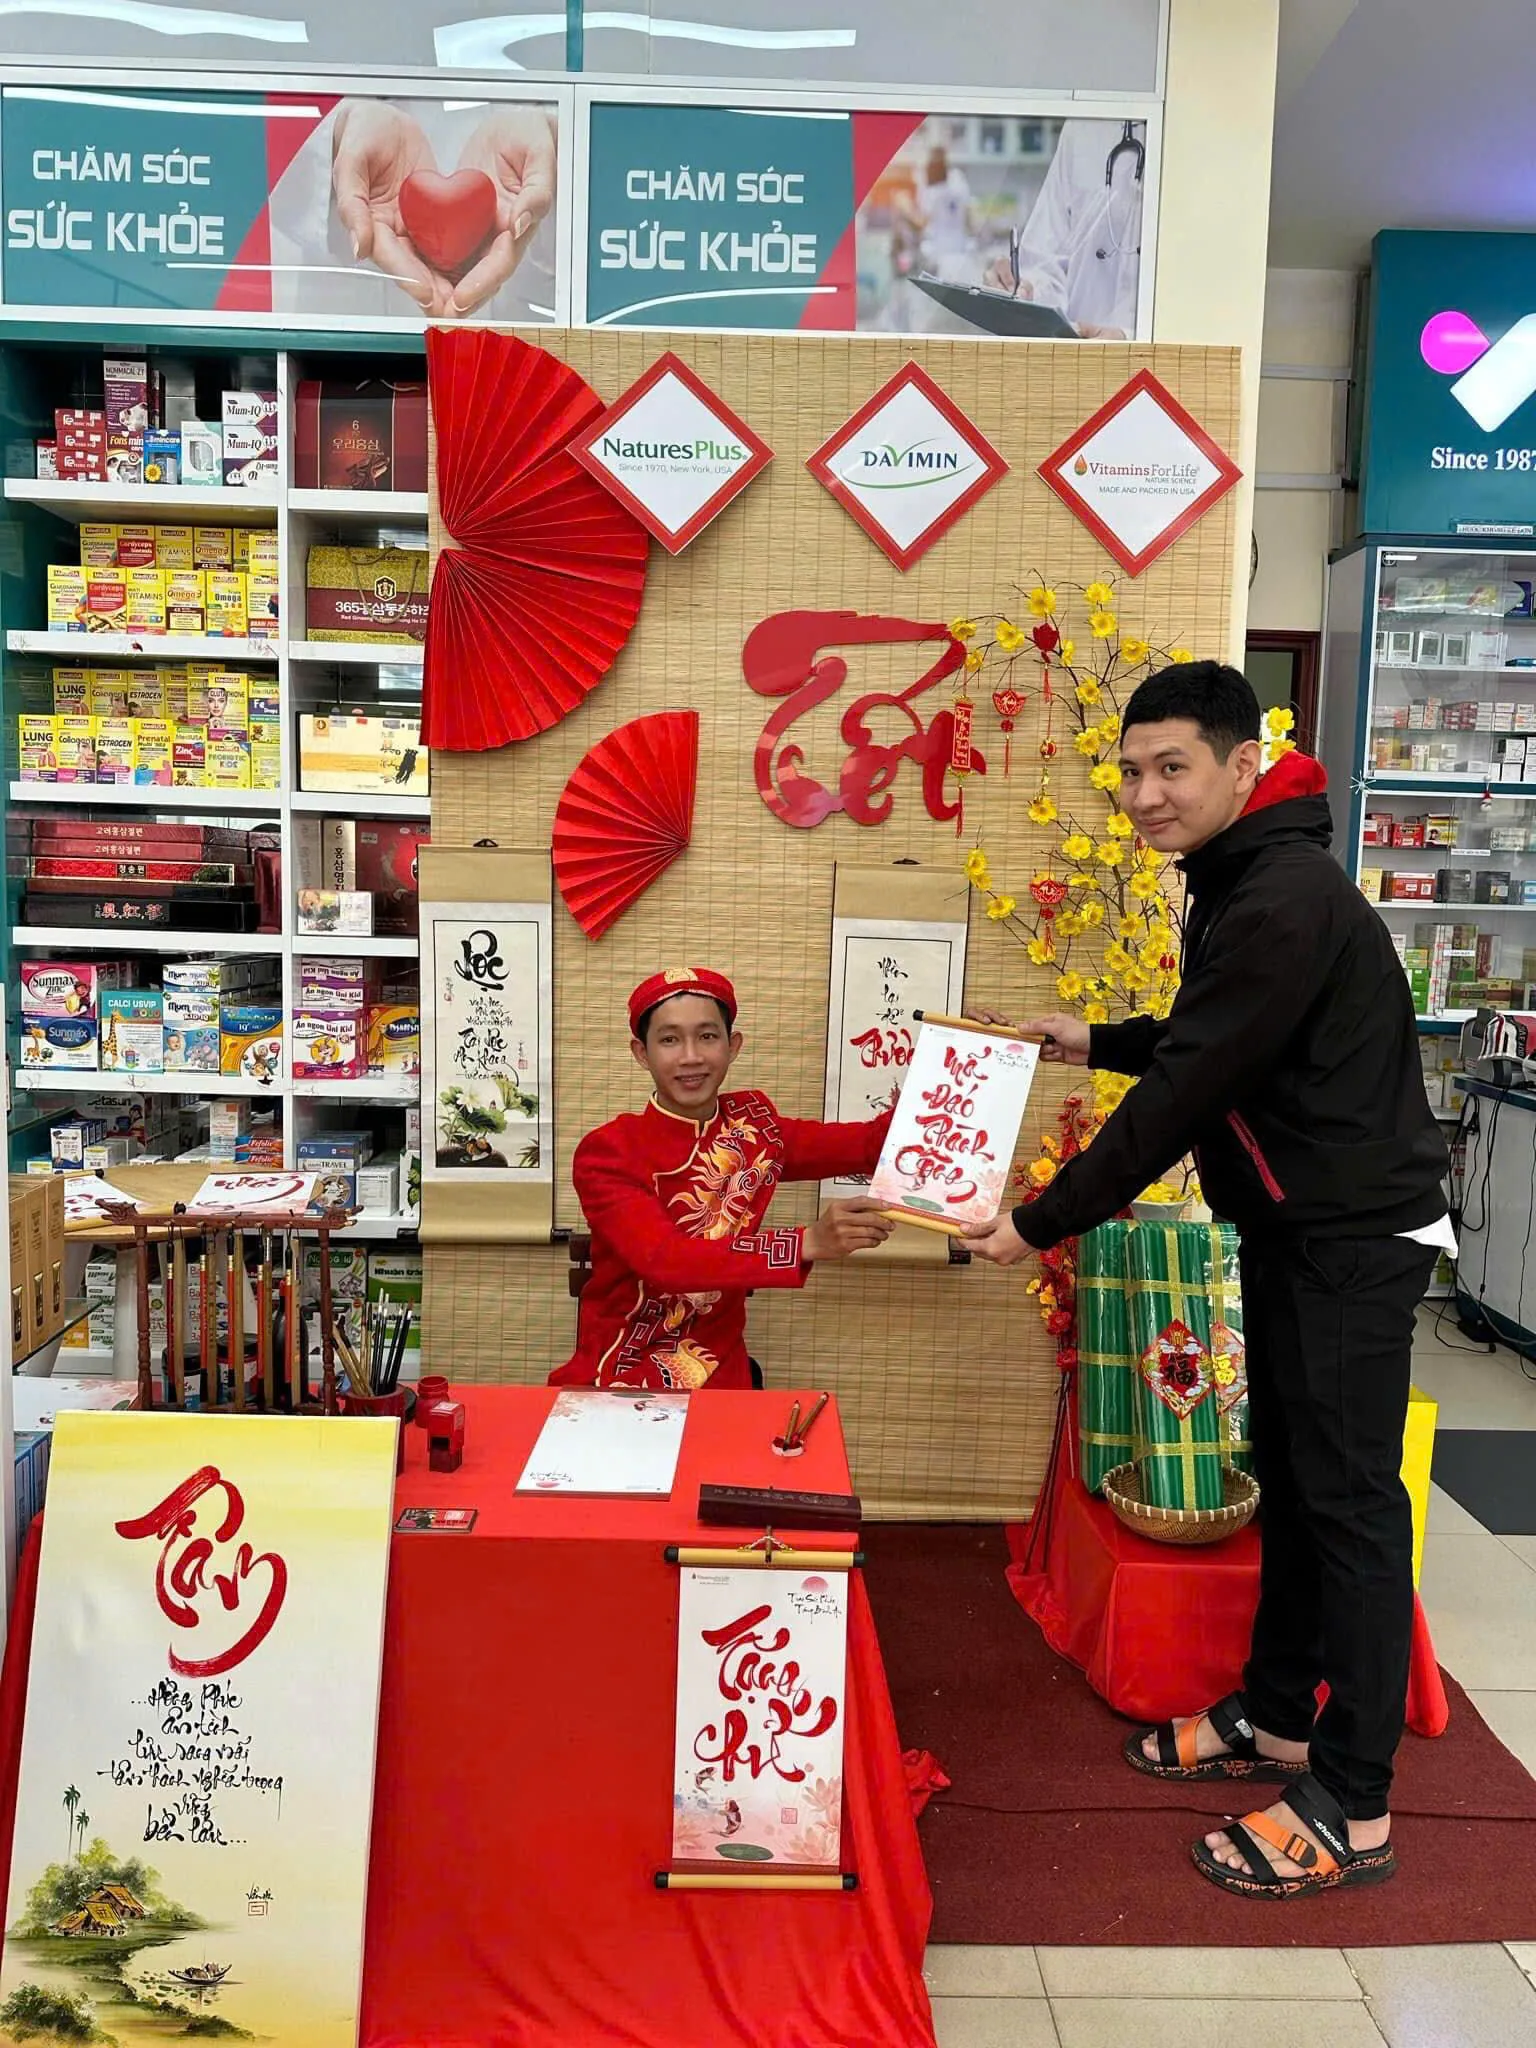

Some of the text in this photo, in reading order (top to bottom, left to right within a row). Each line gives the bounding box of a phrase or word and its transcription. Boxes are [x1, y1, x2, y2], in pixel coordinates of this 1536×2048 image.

[32, 145, 211, 186] CHĂM SÓC
[626, 164, 804, 204] CHĂM SÓC
[8, 199, 225, 256] SỨC KHỎE
[600, 220, 817, 274] SỨC KHỎE
[352, 419, 360, 431] 6
[860, 444, 958, 470] DAVIMIN
[1431, 446, 1488, 470] Since
[619, 463, 643, 473] Since
[670, 464, 690, 474] New
[714, 466, 733, 475] USA
[1099, 486, 1121, 494] MADE
[1139, 487, 1169, 495] PACKED
[56, 685, 86, 694] LUNG
[23, 732, 54, 742] LUNG
[98, 740, 132, 748] ESTROGEN
[335, 825, 343, 836] 6
[32, 975, 76, 987] Sunmax
[108, 999, 130, 1008] CALCI
[307, 1022, 325, 1031] ngon
[326, 1023, 338, 1032] Uni
[340, 1024, 353, 1032] Kid
[922, 1081, 980, 1118] Đáo
[915, 1113, 996, 1162] Thành
[895, 1144, 978, 1204] Công
[116, 1465, 288, 1678] Tâm
